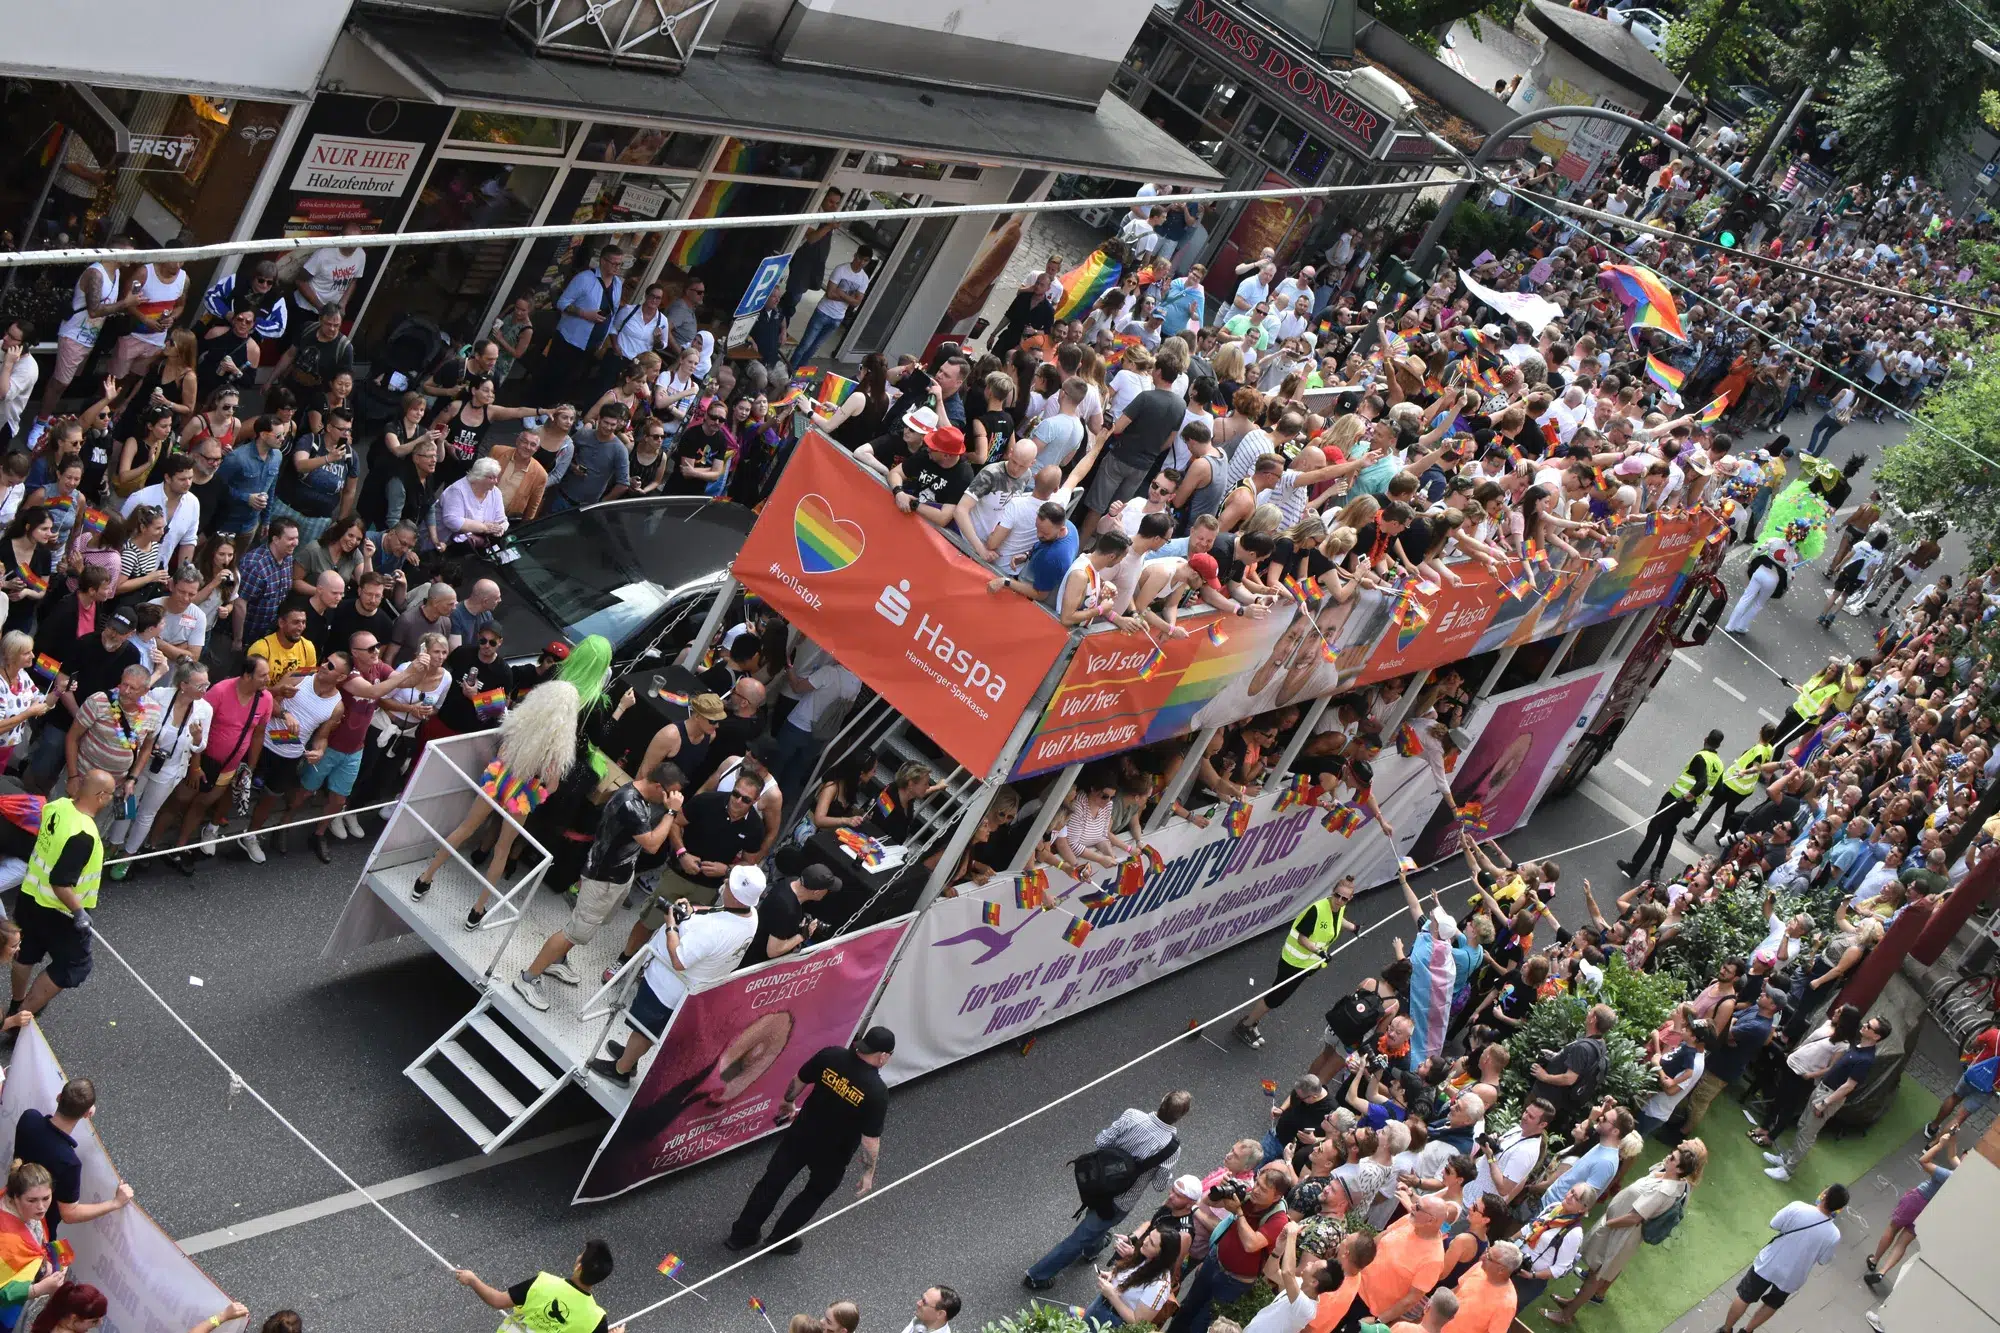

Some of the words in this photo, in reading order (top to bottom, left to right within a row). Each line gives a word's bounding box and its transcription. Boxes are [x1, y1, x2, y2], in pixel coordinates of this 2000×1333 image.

[1184, 0, 1264, 61] MISS
[1259, 46, 1378, 142] DÖNER
[311, 146, 359, 167] NUR
[359, 150, 411, 170] HIER
[305, 173, 395, 193] Holzofenbrot
[745, 264, 779, 308] P
[768, 562, 823, 612] #vollstolz
[913, 613, 1007, 703] Haspa
[1086, 651, 1120, 675] Voll
[1116, 647, 1155, 671] stol
[905, 649, 953, 689] Hamburger
[950, 684, 990, 721] Sparkasse
[1060, 695, 1094, 717] Voll
[1037, 733, 1070, 760] Voll
[1068, 723, 1138, 751] Hamburg.
[957, 961, 1044, 1016] fordert
[1039, 953, 1077, 986] die
[1121, 901, 1212, 957] rechtliche
[1207, 862, 1319, 920] Gleichstellung
[1312, 851, 1343, 880] für
[1319, 921, 1329, 930] 56
[1156, 930, 1196, 968] und
[751, 972, 824, 1010] GLEICH
[821, 1070, 864, 1104] SICHERHEIT
[651, 1114, 765, 1170] VERFASSUNG
[661, 1131, 687, 1153] FÜR
[687, 1120, 719, 1141] EINE
[719, 1098, 772, 1127] BESSERE
